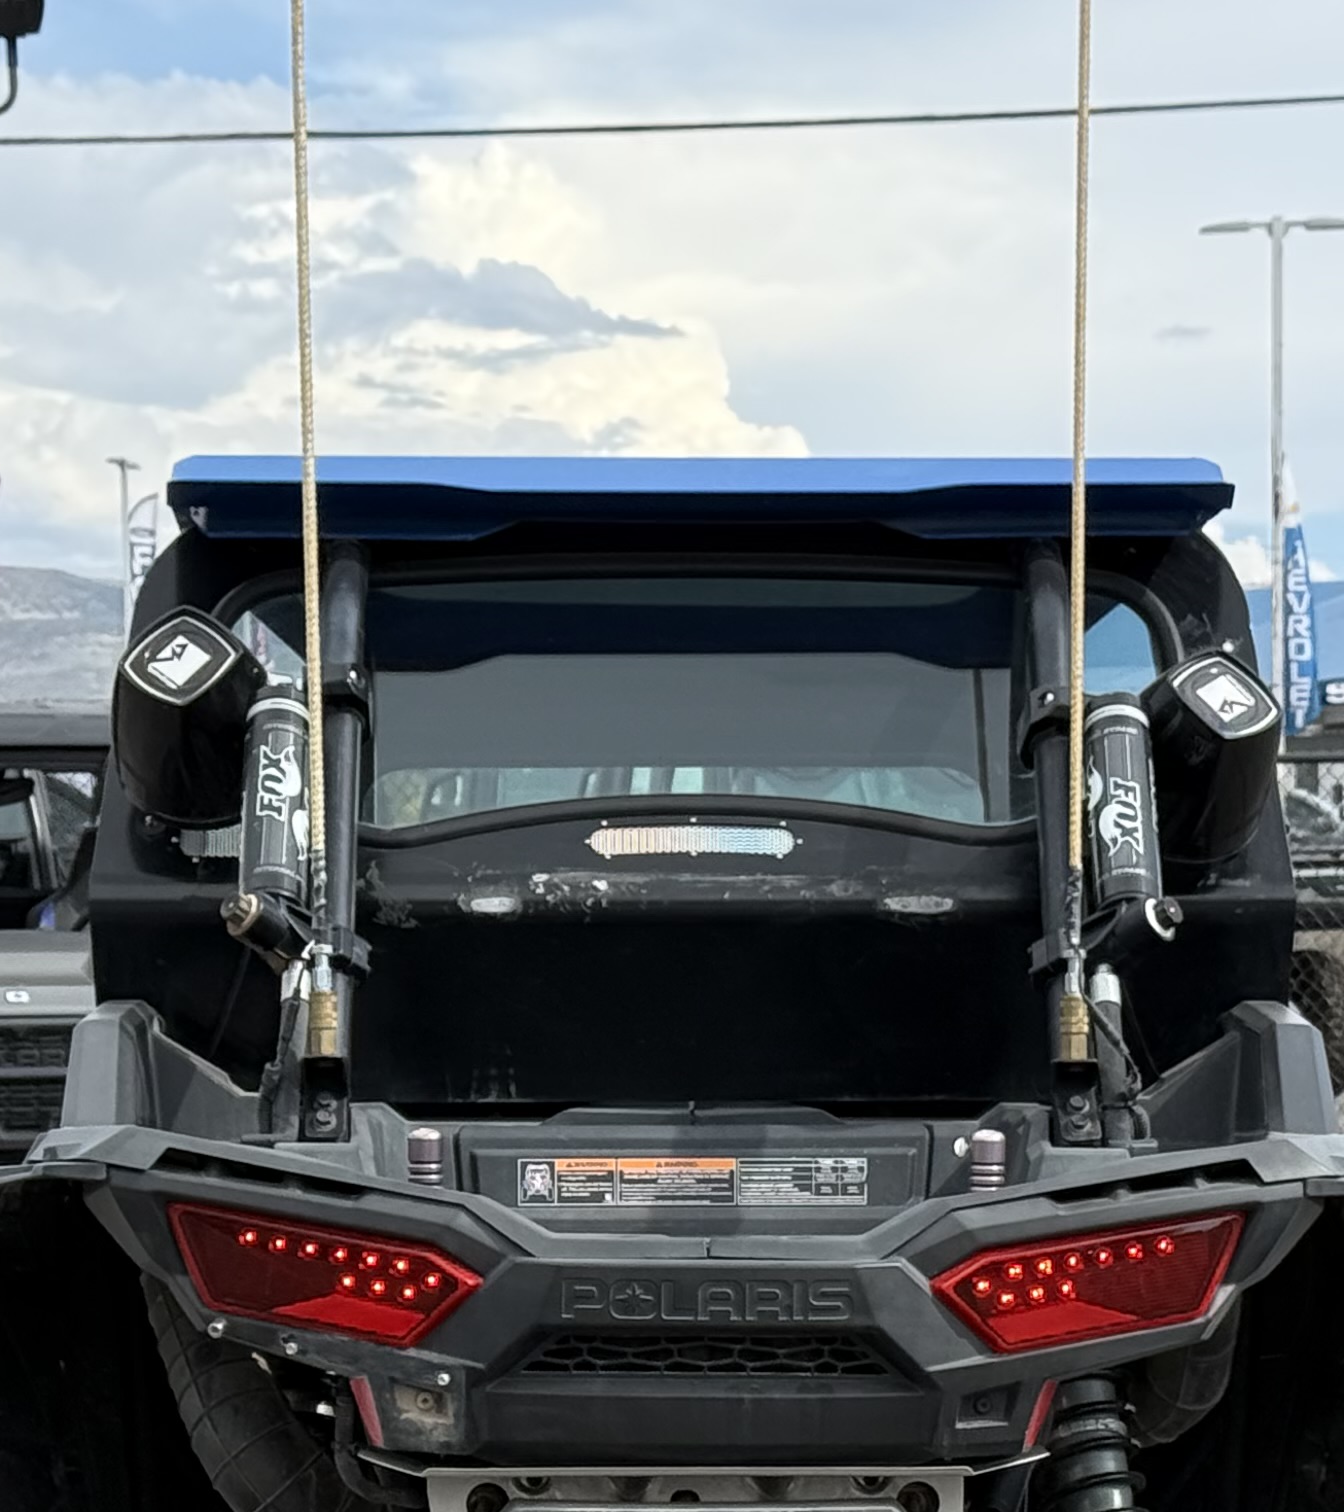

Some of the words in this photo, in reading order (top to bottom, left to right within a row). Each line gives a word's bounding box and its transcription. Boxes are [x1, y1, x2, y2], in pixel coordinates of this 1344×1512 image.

[256, 744, 302, 822] FOX
[1099, 776, 1145, 858] FOX
[560, 1278, 854, 1321] POLARIS
